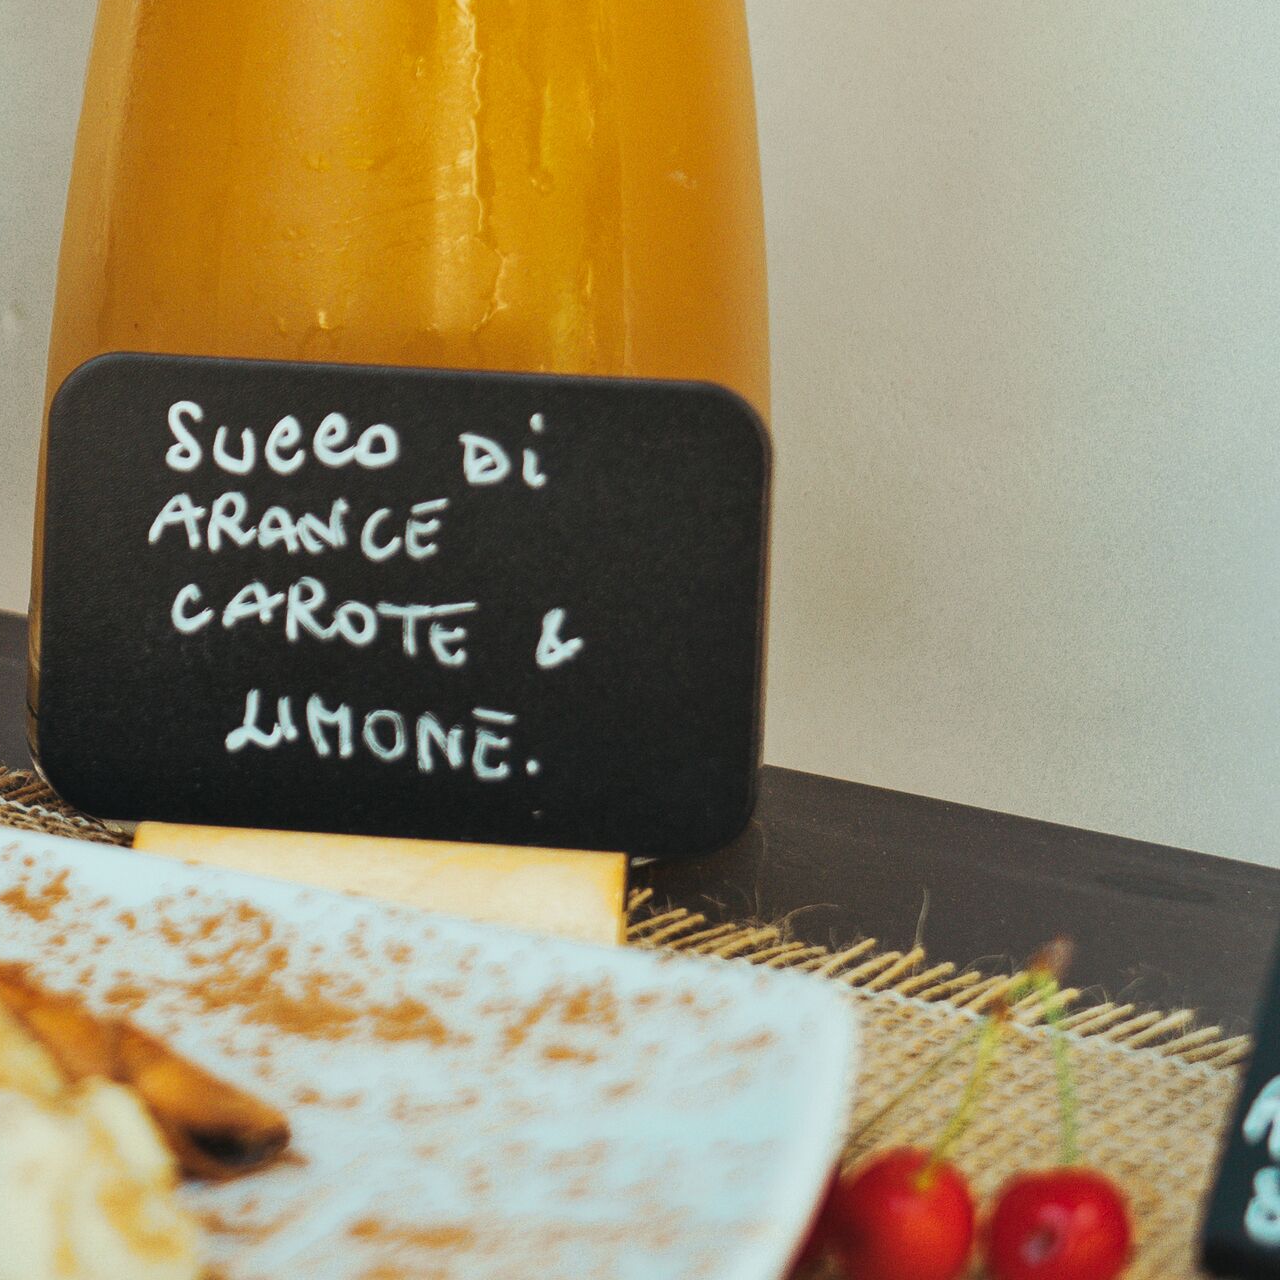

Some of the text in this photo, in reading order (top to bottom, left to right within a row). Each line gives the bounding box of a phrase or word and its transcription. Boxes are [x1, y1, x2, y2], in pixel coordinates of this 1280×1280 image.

[147, 491, 448, 562] ARANCE
[170, 576, 477, 667] CAROTE
[224, 689, 539, 780] LIMONE.
